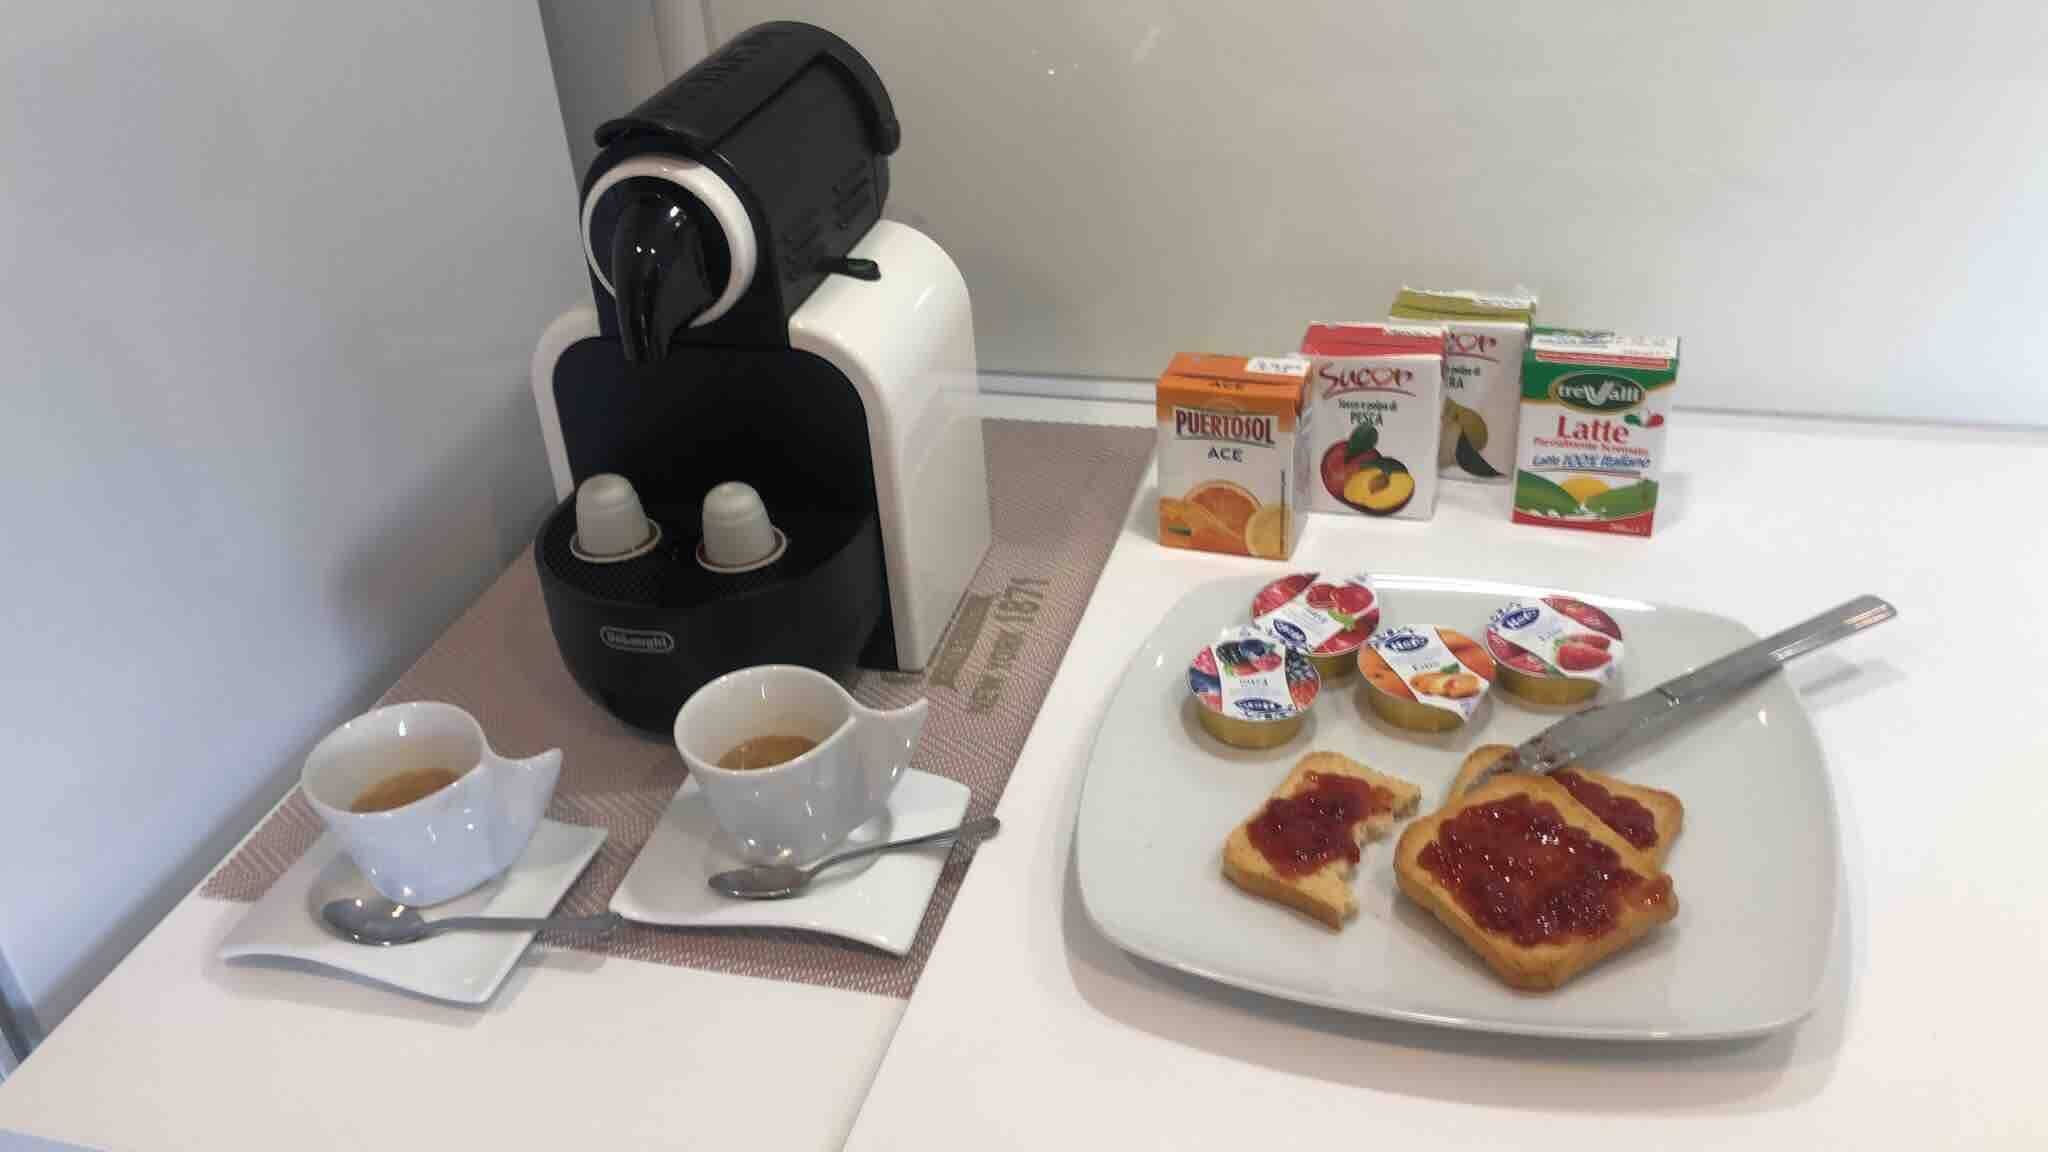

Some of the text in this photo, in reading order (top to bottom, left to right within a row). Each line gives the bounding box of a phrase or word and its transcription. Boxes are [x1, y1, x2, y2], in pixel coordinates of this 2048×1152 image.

[1175, 409, 1275, 445] PUERTOSOL
[1350, 411, 1384, 426] PESCA
[1556, 414, 1630, 444] Latte
[1207, 446, 1244, 463] ACE
